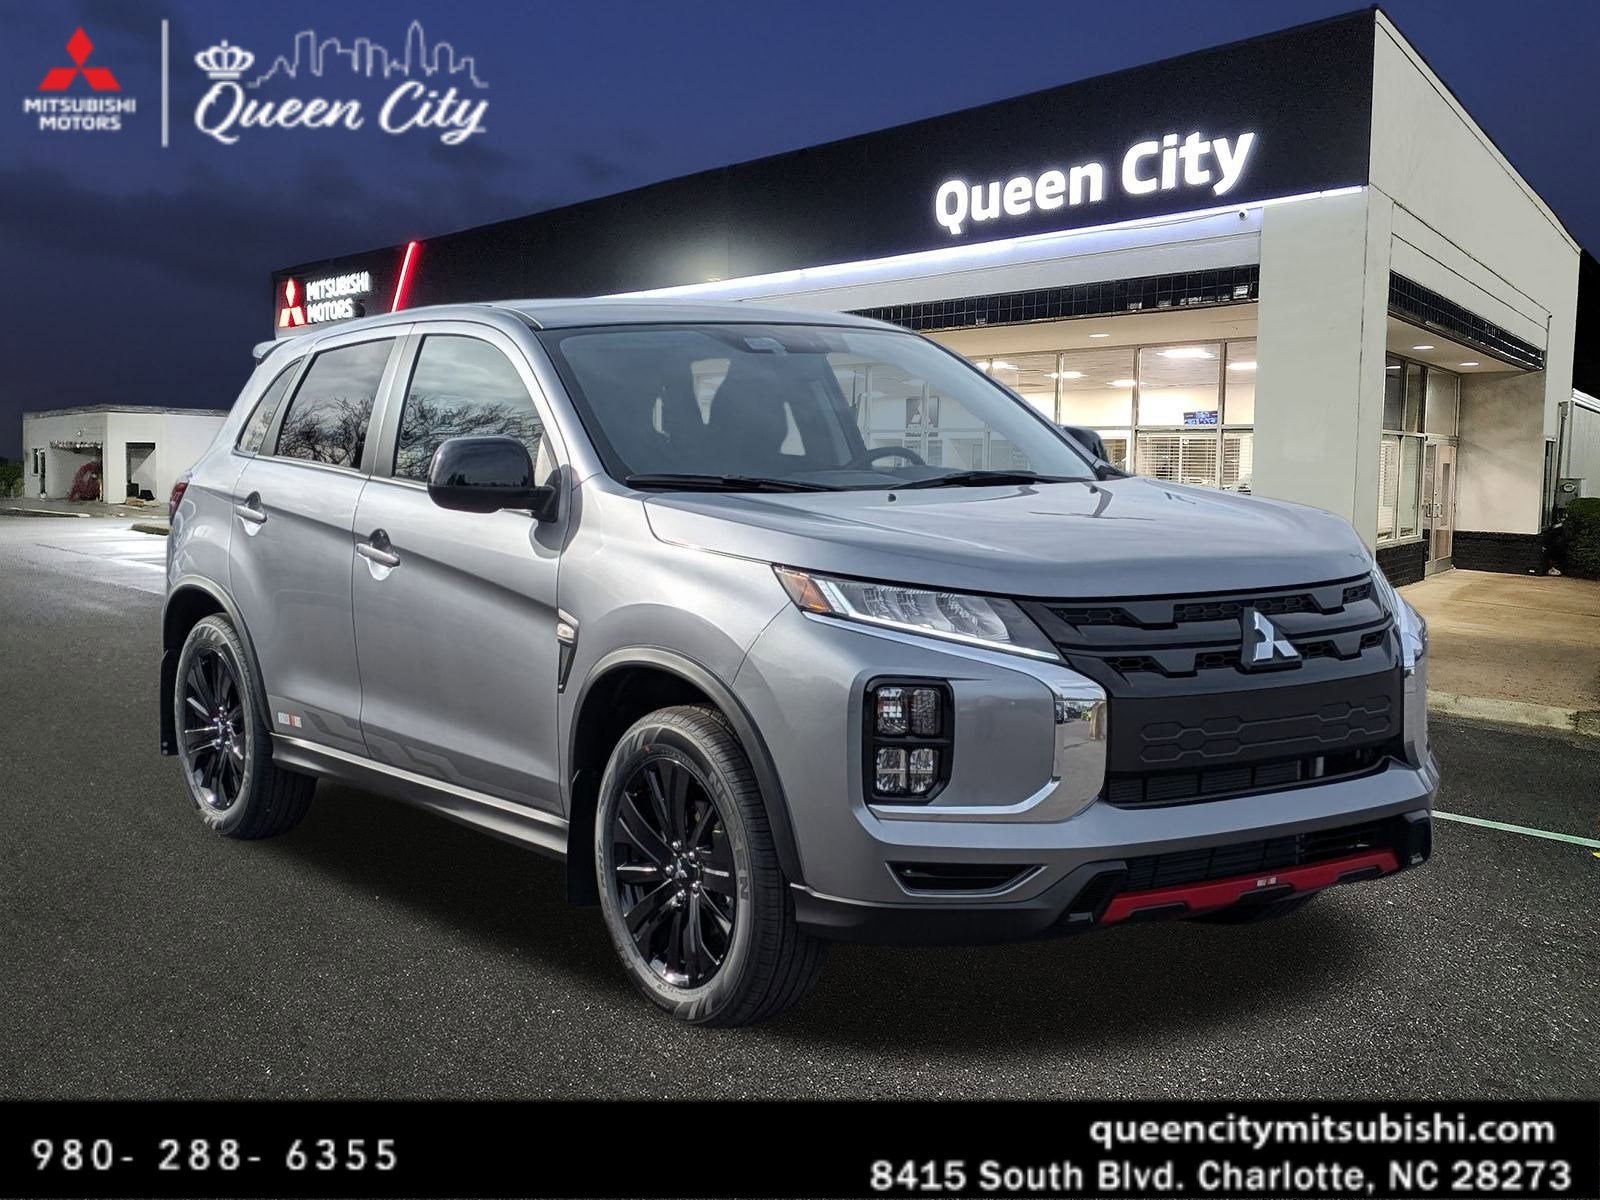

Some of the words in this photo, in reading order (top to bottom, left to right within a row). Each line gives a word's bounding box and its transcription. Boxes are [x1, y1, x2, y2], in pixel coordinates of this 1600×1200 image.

[934, 160, 1104, 235] Queen
[1121, 131, 1256, 196] City
[305, 270, 371, 302] MITSUBISHI
[306, 298, 354, 324] MOTORS
